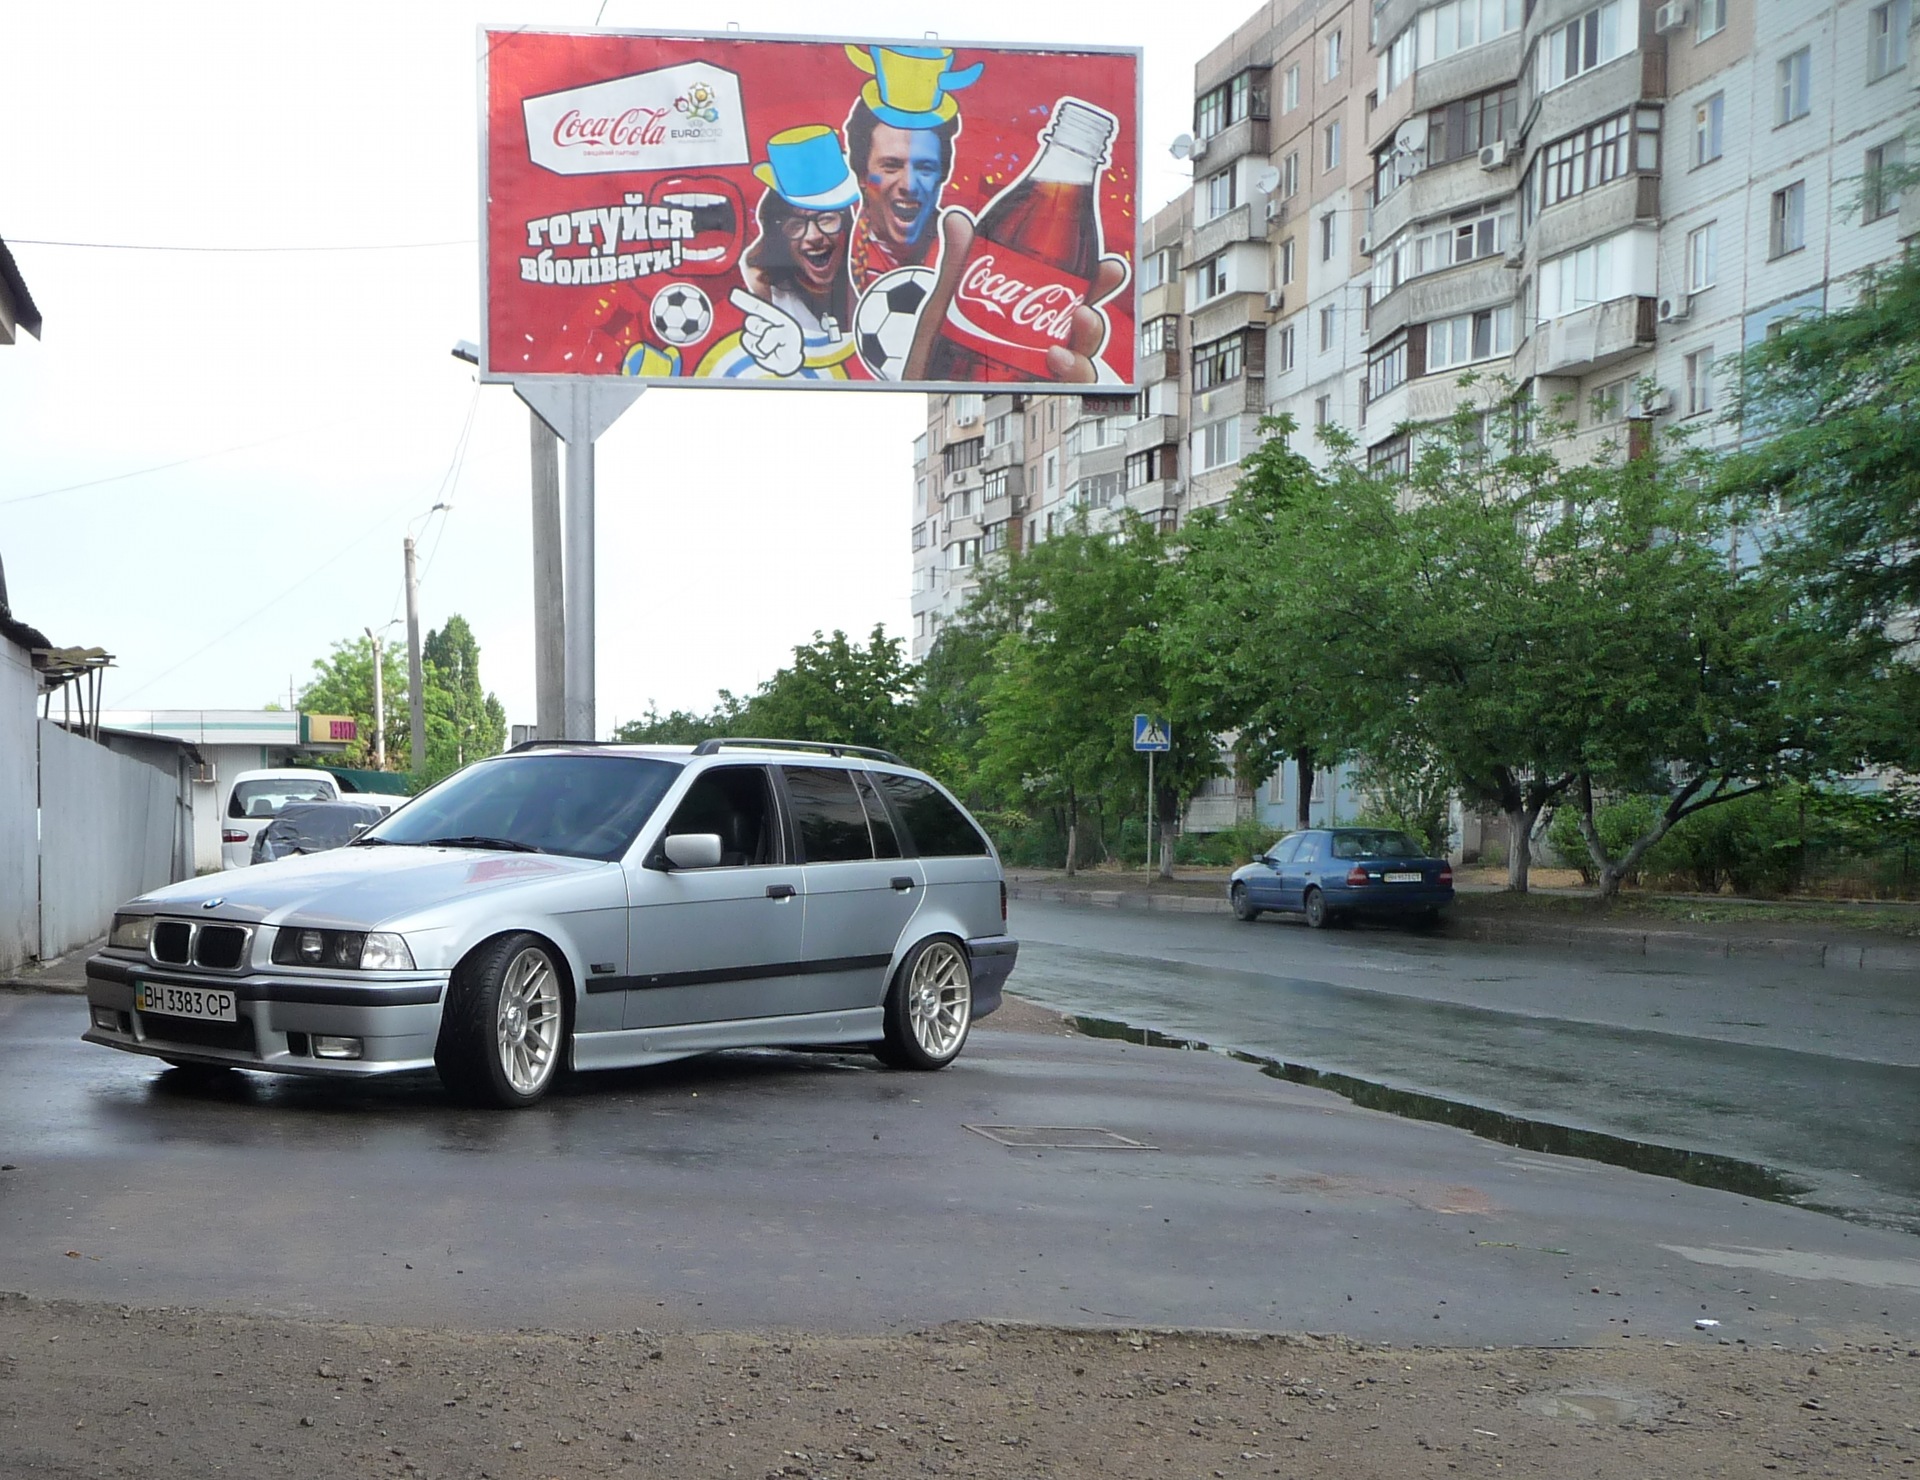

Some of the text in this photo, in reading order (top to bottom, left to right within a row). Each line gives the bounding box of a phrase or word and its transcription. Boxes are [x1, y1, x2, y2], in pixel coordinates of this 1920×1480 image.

[553, 107, 672, 147] Coca-Cola
[958, 255, 1084, 340] Coca-Cola
[144, 986, 231, 1016] BH 3383 CP
